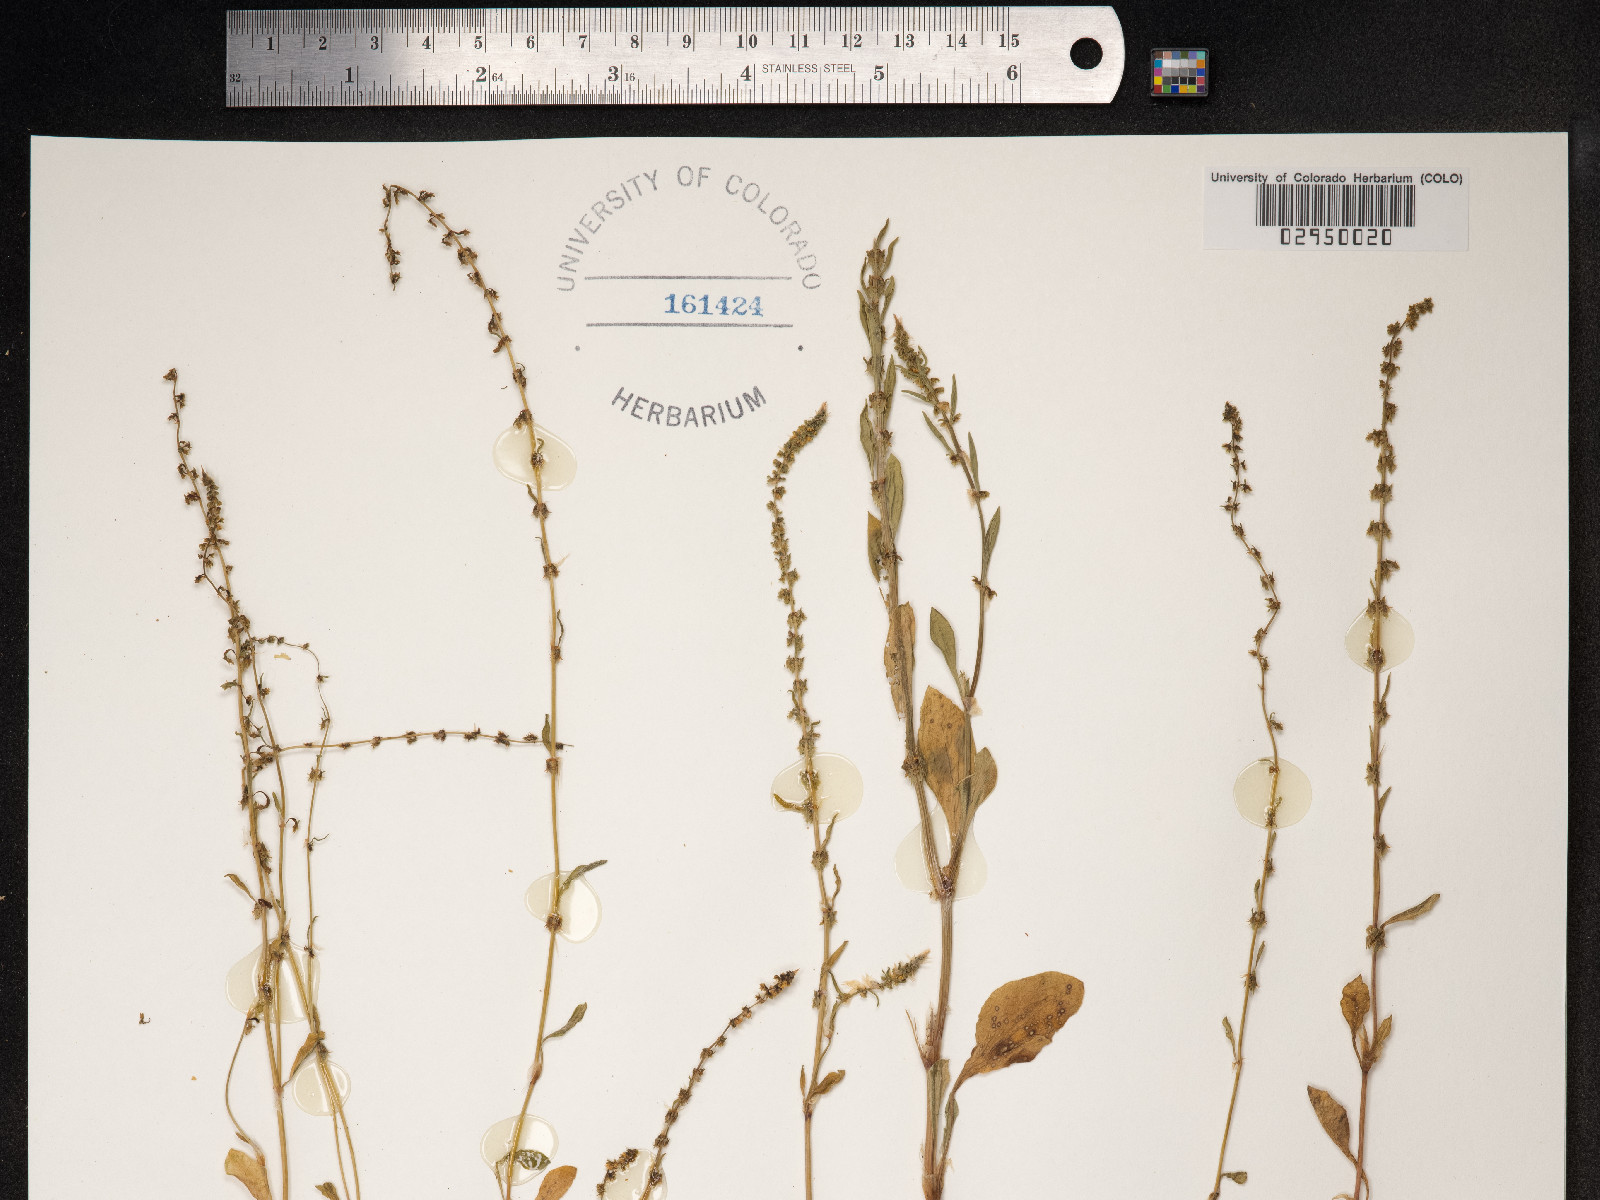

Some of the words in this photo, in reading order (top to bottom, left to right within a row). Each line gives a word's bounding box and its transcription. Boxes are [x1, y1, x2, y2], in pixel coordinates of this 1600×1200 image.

[266, 36, 274, 51] 1
[318, 36, 327, 51] 2
[370, 36, 379, 51] 3
[421, 36, 432, 50] 4
[474, 36, 483, 50] 5
[526, 35, 535, 50] 6
[578, 35, 588, 50] 7
[630, 35, 639, 50] 8
[682, 35, 691, 49] 9
[736, 34, 758, 49] 10
[789, 34, 810, 48] 11
[841, 34, 863, 48] 12
[893, 34, 915, 48] 13
[946, 34, 968, 48] 14
[998, 34, 1020, 48] 15
[230, 73, 241, 82] 32
[344, 67, 353, 83] 1
[475, 66, 487, 82] 2
[492, 73, 504, 82] 64
[608, 66, 619, 82] 3
[625, 72, 635, 81] 16
[740, 66, 752, 82] 4
[873, 65, 885, 81] 5
[1007, 65, 1018, 81] 6
[761, 64, 819, 74] STAINLESS
[823, 64, 856, 73] STEEL
[1211, 172, 1268, 184] University
[1276, 173, 1287, 182] of
[1294, 173, 1346, 183] Colorado
[1353, 173, 1412, 183] Herbarium
[1420, 173, 1463, 185] (COLO)
[557, 169, 659, 292] UNIVERSITY
[677, 165, 711, 187] OF
[725, 174, 821, 291] COLORADO
[1280, 229, 1392, 245] 02950020
[664, 294, 764, 317] 161424
[611, 386, 767, 428] HERBARIUM
